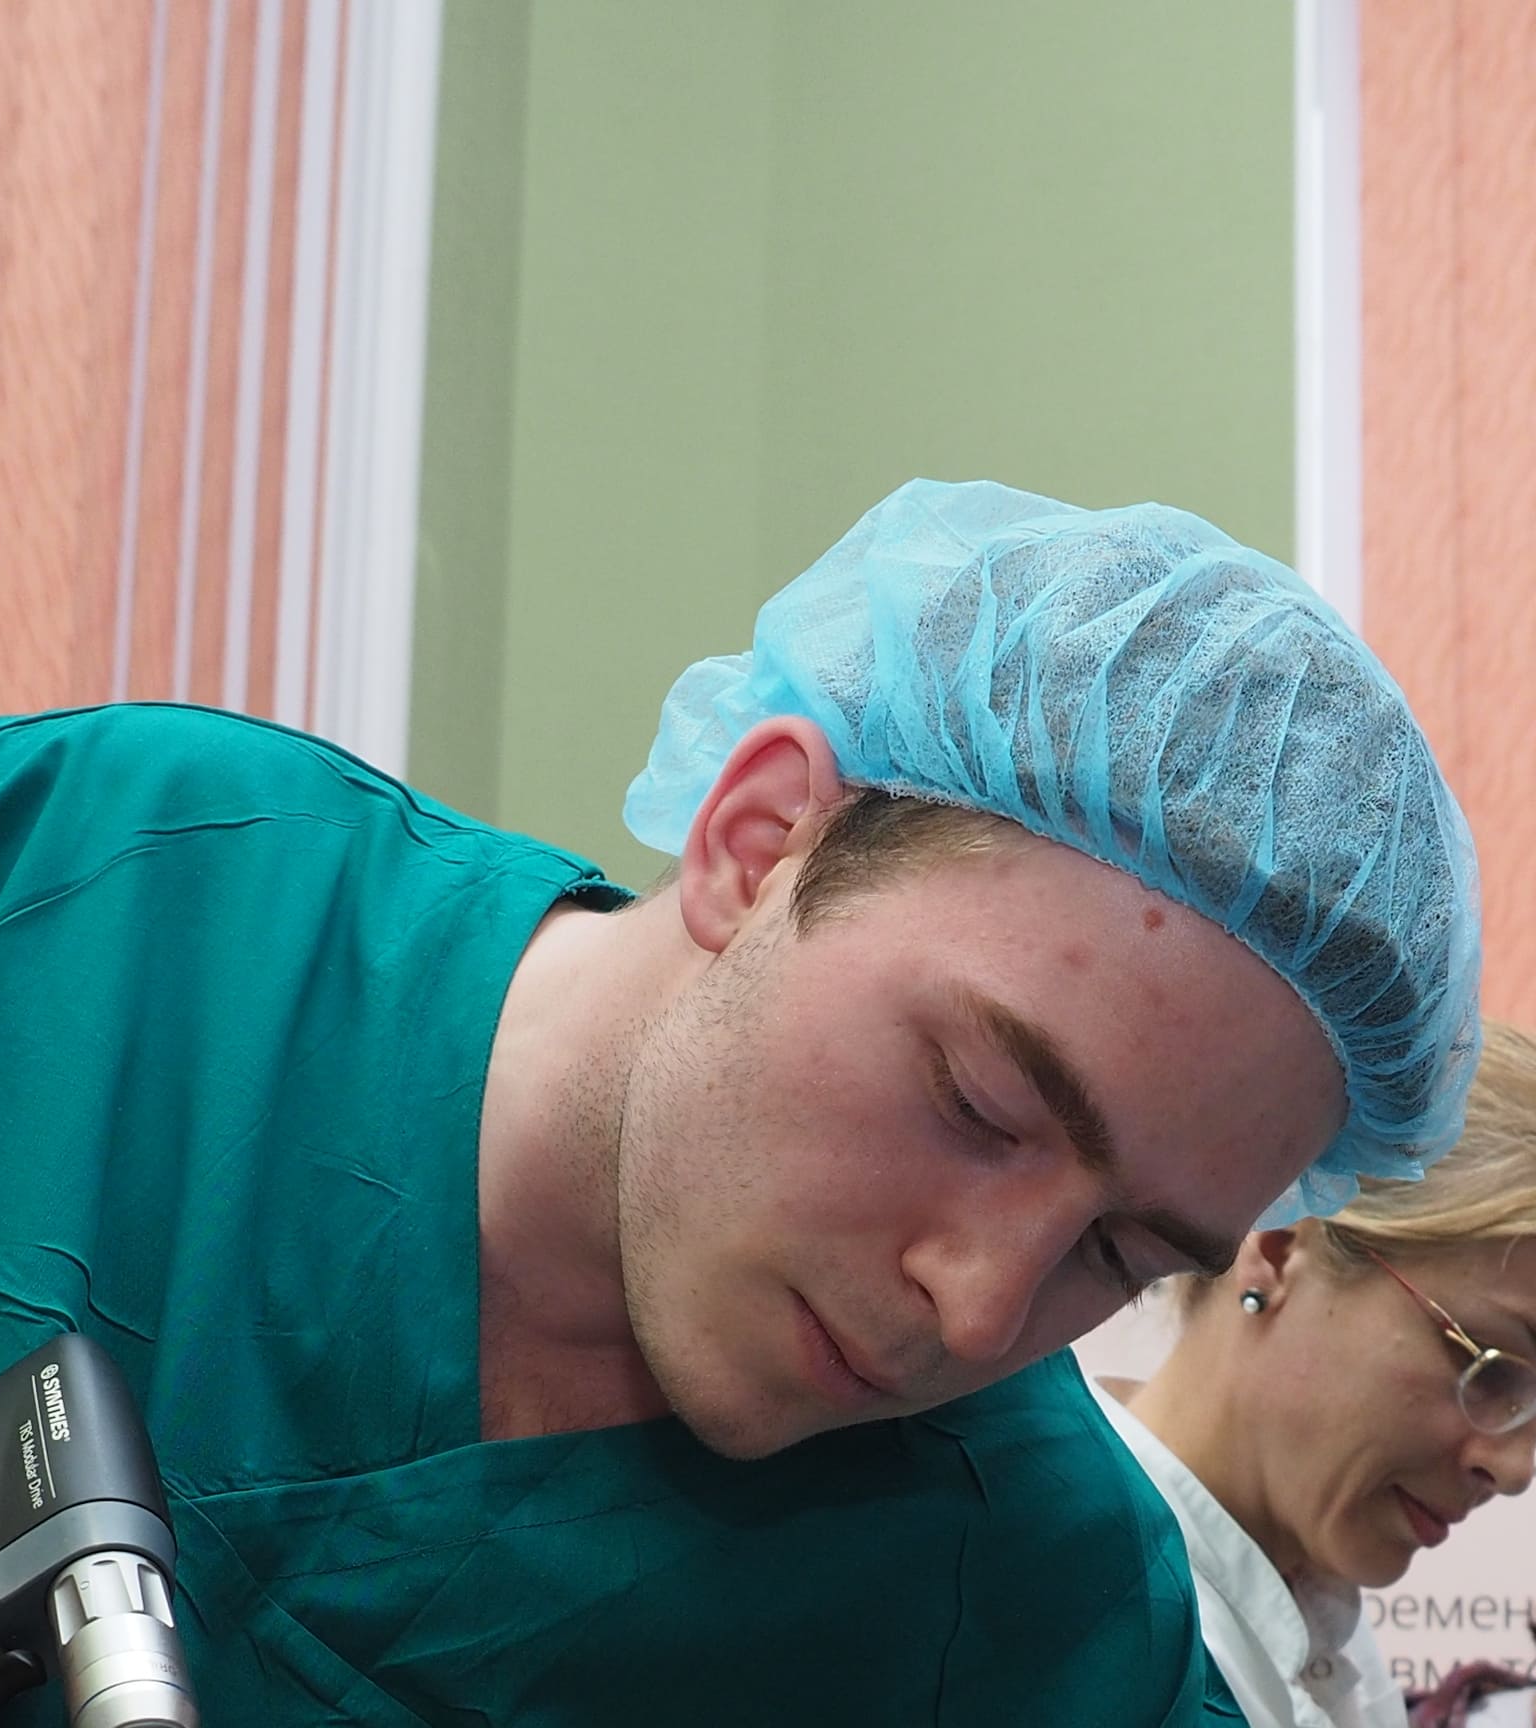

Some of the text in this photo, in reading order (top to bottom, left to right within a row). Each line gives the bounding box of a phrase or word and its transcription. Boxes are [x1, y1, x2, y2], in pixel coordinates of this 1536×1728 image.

[42, 1377, 70, 1442] SYNTHES
[18, 1419, 45, 1510] TRS Modular Drive
